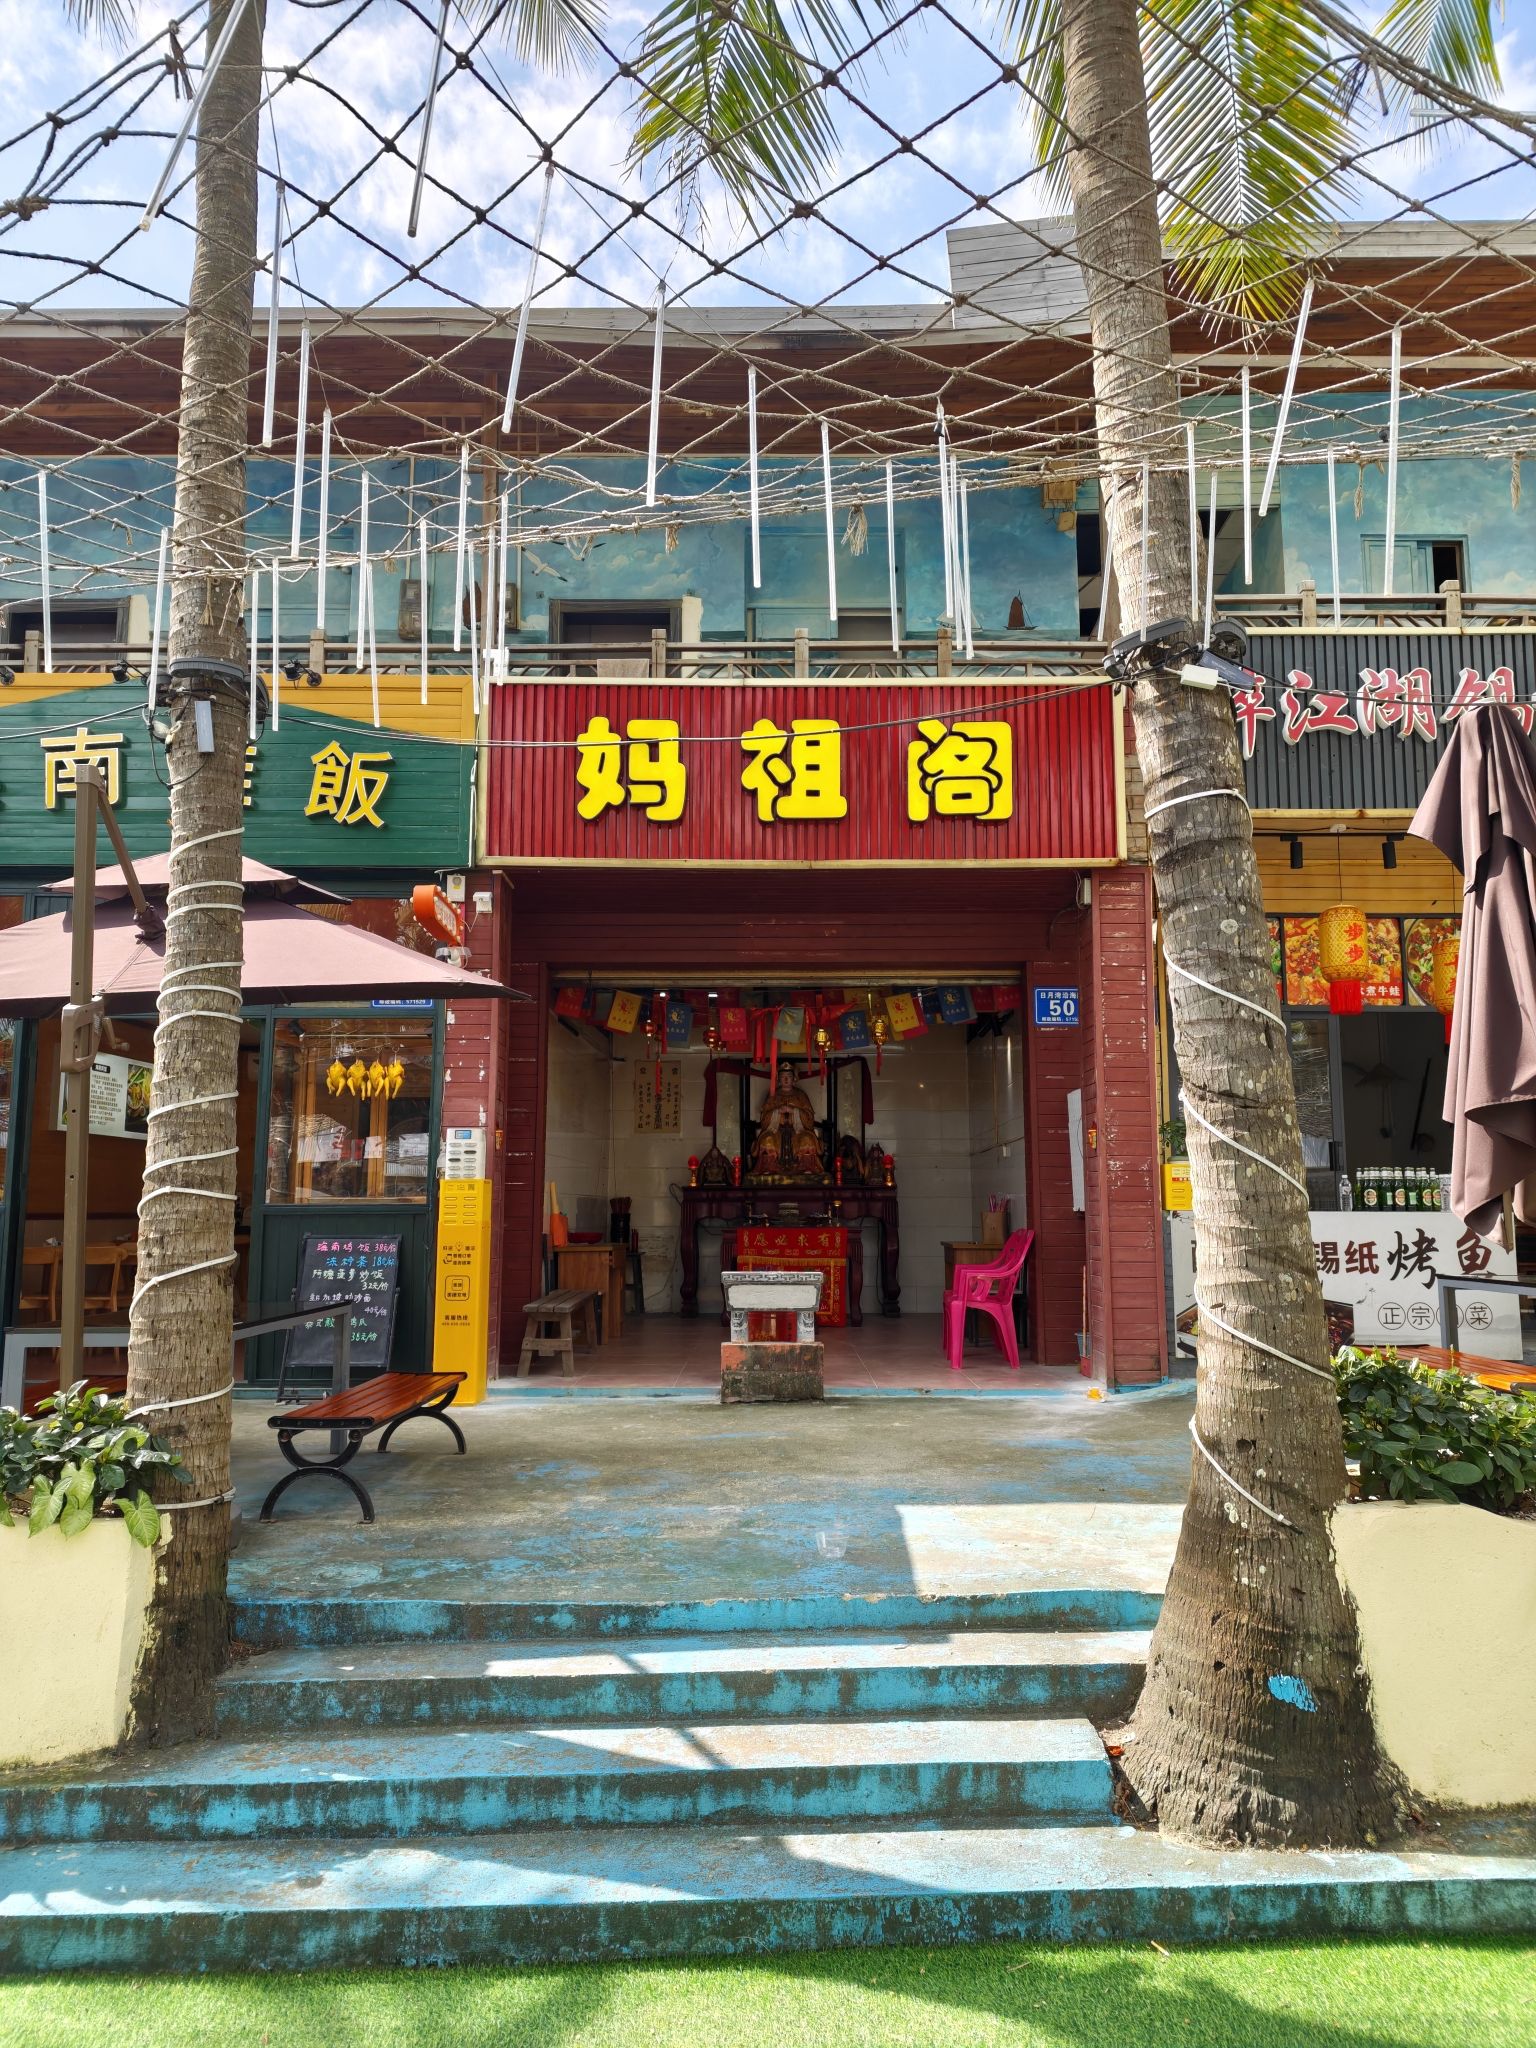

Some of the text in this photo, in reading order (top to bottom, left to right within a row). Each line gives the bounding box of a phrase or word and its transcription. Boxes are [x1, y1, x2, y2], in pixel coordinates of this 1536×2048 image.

[576, 716, 1015, 823] 妈祖阁
[1050, 999, 1074, 1016] 50
[1378, 1303, 1493, 1330] 正宗菜
